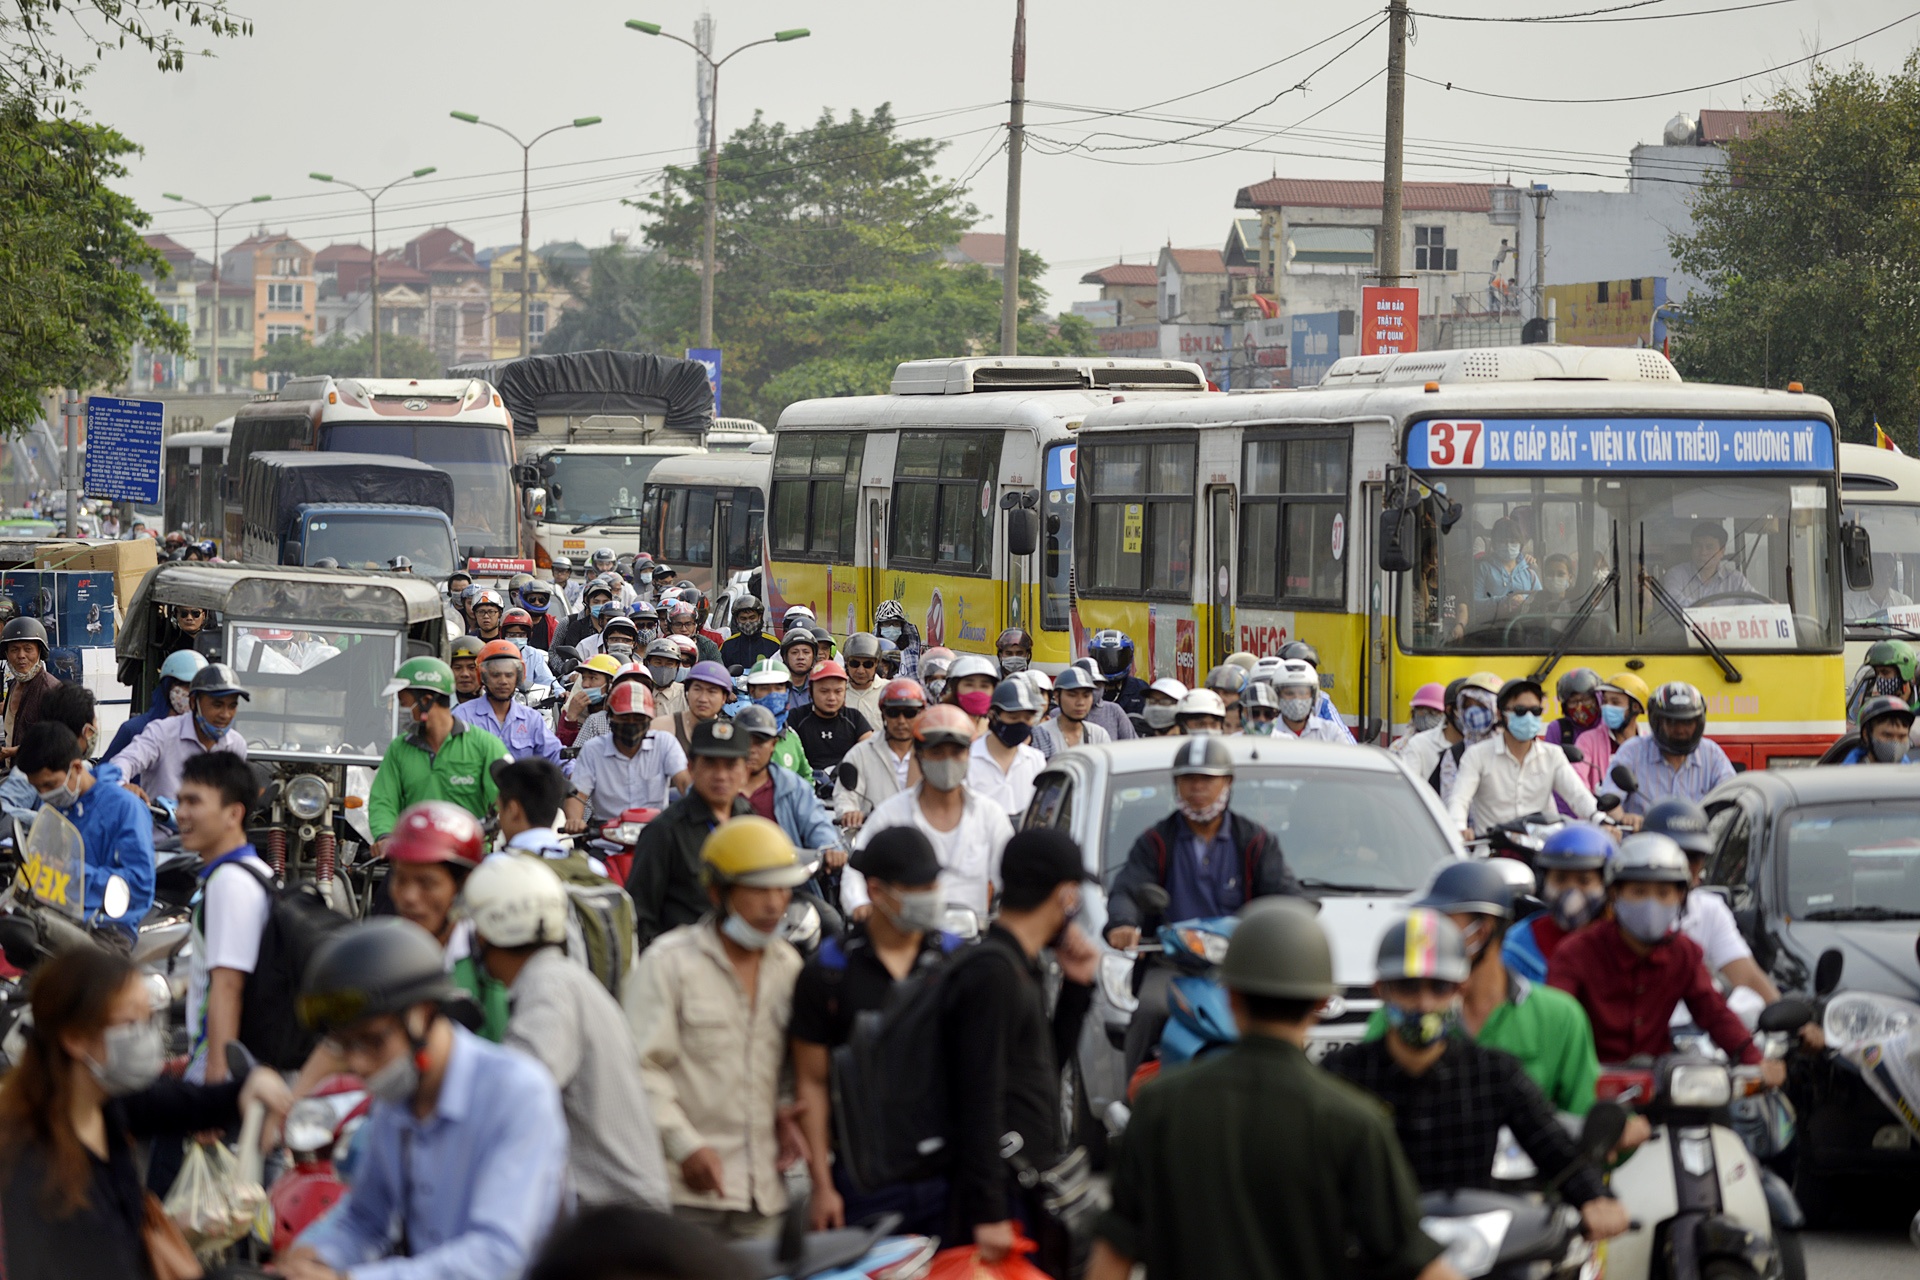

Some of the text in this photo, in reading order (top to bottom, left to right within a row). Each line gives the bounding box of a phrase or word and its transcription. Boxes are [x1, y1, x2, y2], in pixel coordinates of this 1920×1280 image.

[1377, 299, 1404, 311] ĐẢM BẢO
[1378, 315, 1392, 327] TRẬT
[1377, 330, 1403, 341] MỸ QUAN
[1430, 422, 1482, 466] 37
[1490, 431, 1510, 461] BX
[1513, 425, 1547, 462] GIÁP
[1551, 425, 1577, 461] BÁT
[1590, 425, 1623, 467] VIỆN
[1627, 431, 1637, 461] K
[1640, 424, 1672, 463] (TÂN
[1675, 421, 1720, 463] TRIỀU)
[1733, 428, 1790, 462] CHƯƠNG
[1793, 426, 1814, 462] MỸ
[1333, 522, 1343, 550] 37
[78, 579, 90, 588] APT
[1738, 615, 1769, 640] BÁT
[1905, 612, 1920, 629] PH
[1177, 652, 1194, 668] ENEOS
[414, 670, 442, 682] Grab
[450, 775, 475, 785] Grab
